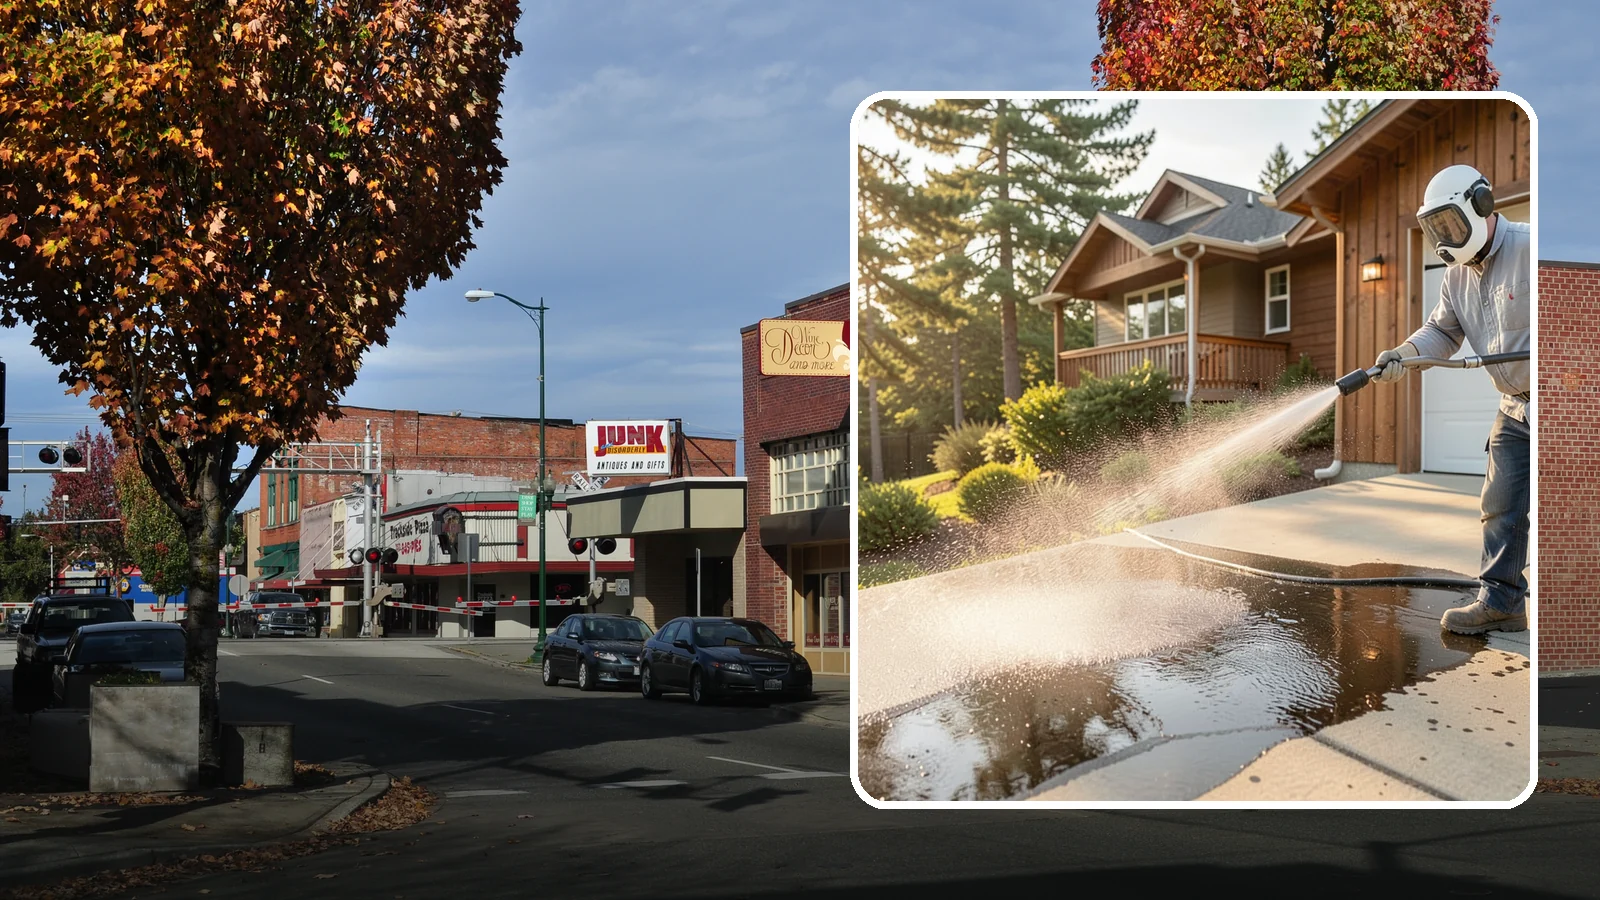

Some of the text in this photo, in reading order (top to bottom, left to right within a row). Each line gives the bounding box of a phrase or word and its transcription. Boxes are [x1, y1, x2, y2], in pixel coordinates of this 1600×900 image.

[595, 425, 665, 457] JUNK
[607, 446, 646, 454] DISORDERLY
[597, 460, 665, 470] ANTIQUES AND GIFTS
